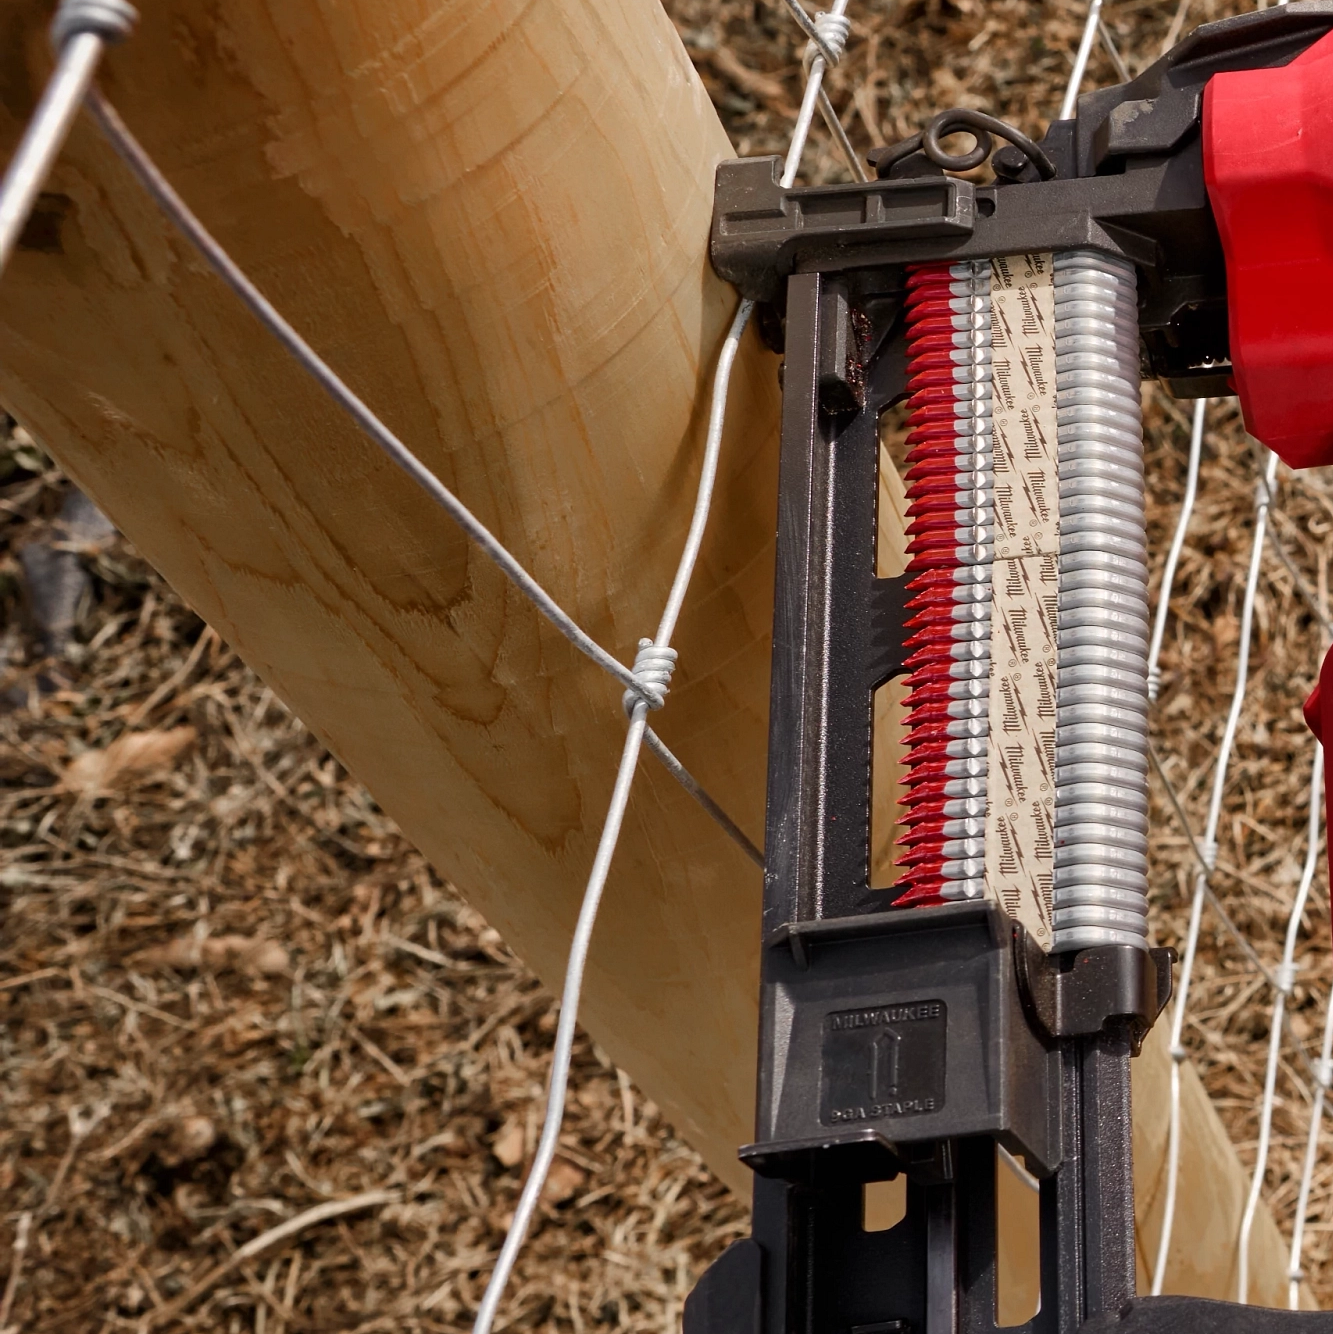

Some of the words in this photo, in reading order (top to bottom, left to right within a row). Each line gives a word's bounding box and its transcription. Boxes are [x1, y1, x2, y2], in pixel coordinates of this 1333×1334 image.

[997, 256, 1015, 289] waukee
[993, 357, 1016, 411] Milwaukee
[1025, 343, 1048, 397] Milwaukee
[1019, 408, 1043, 463] Milwaukee
[994, 482, 1018, 538] Milwaukee
[1027, 467, 1051, 523] Milwaukee
[1008, 605, 1032, 664] Milwaukee
[998, 675, 1022, 736] Milwaukee
[1033, 661, 1056, 722] Milwaukee
[1004, 741, 1028, 803] Milwaukee
[995, 815, 1019, 879] Milwaukee
[1030, 800, 1053, 864] Milwaukee
[831, 1004, 941, 1031] MILWAUKEE
[870, 1098, 935, 1118] STAPLE
